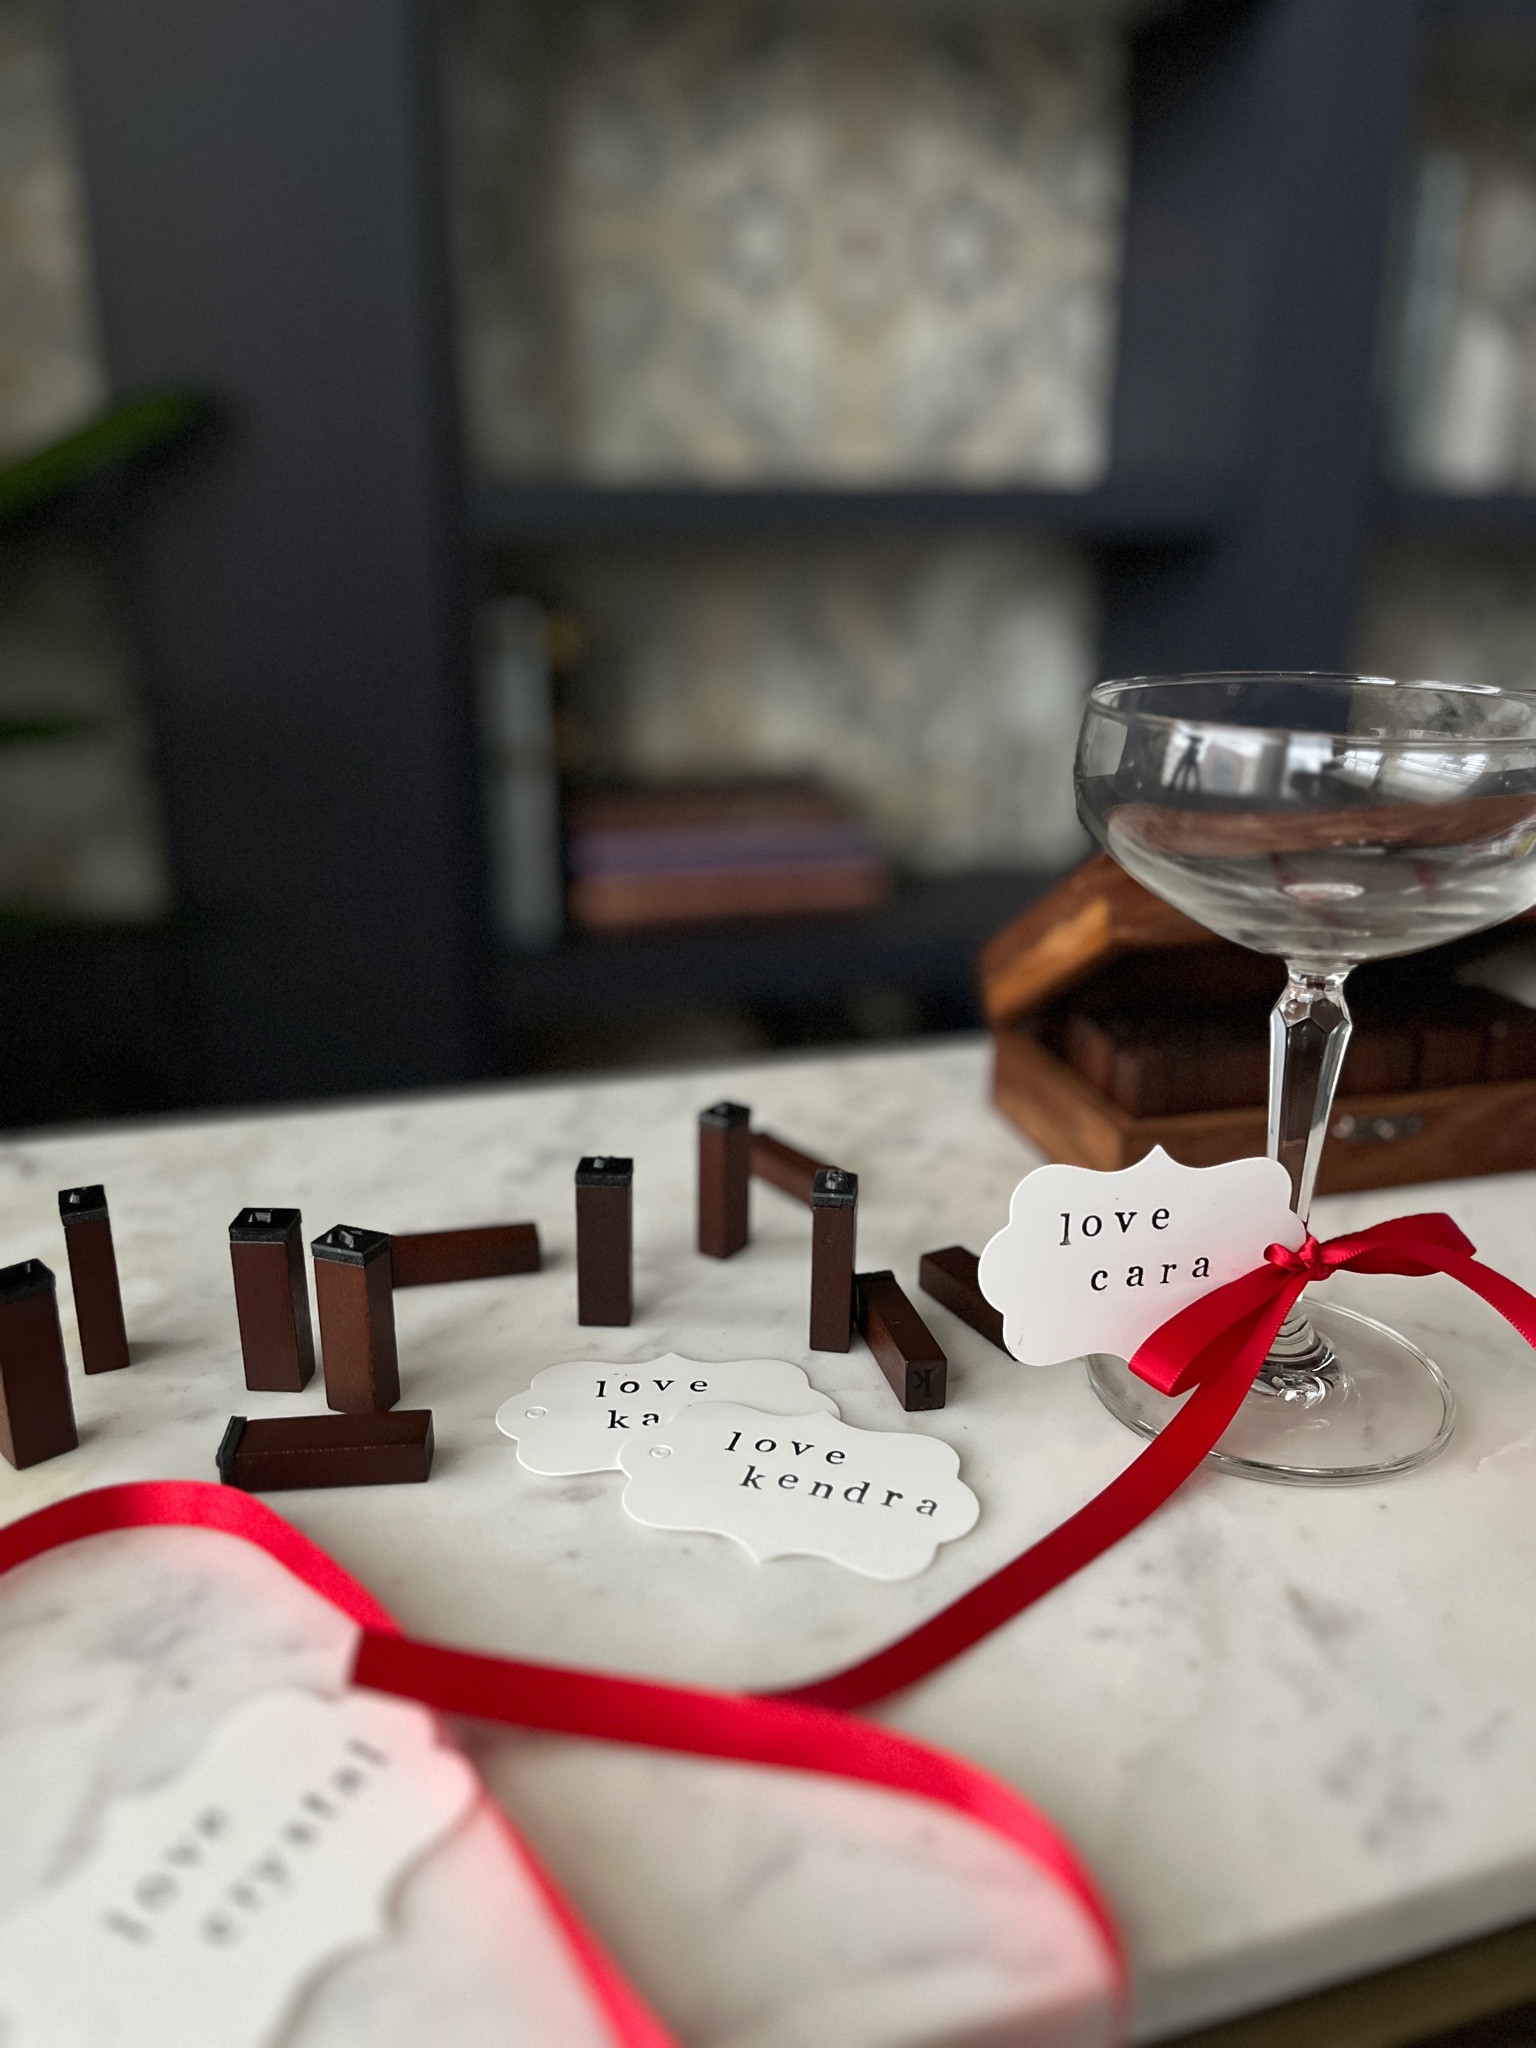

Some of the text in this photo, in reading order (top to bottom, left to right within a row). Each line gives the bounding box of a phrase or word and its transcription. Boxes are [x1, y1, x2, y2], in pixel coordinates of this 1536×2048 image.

[1059, 1208, 1171, 1246] love
[1090, 1256, 1210, 1292] cara
[595, 1379, 708, 1398] love
[724, 1431, 846, 1465] love
[739, 1464, 938, 1517] kendra
